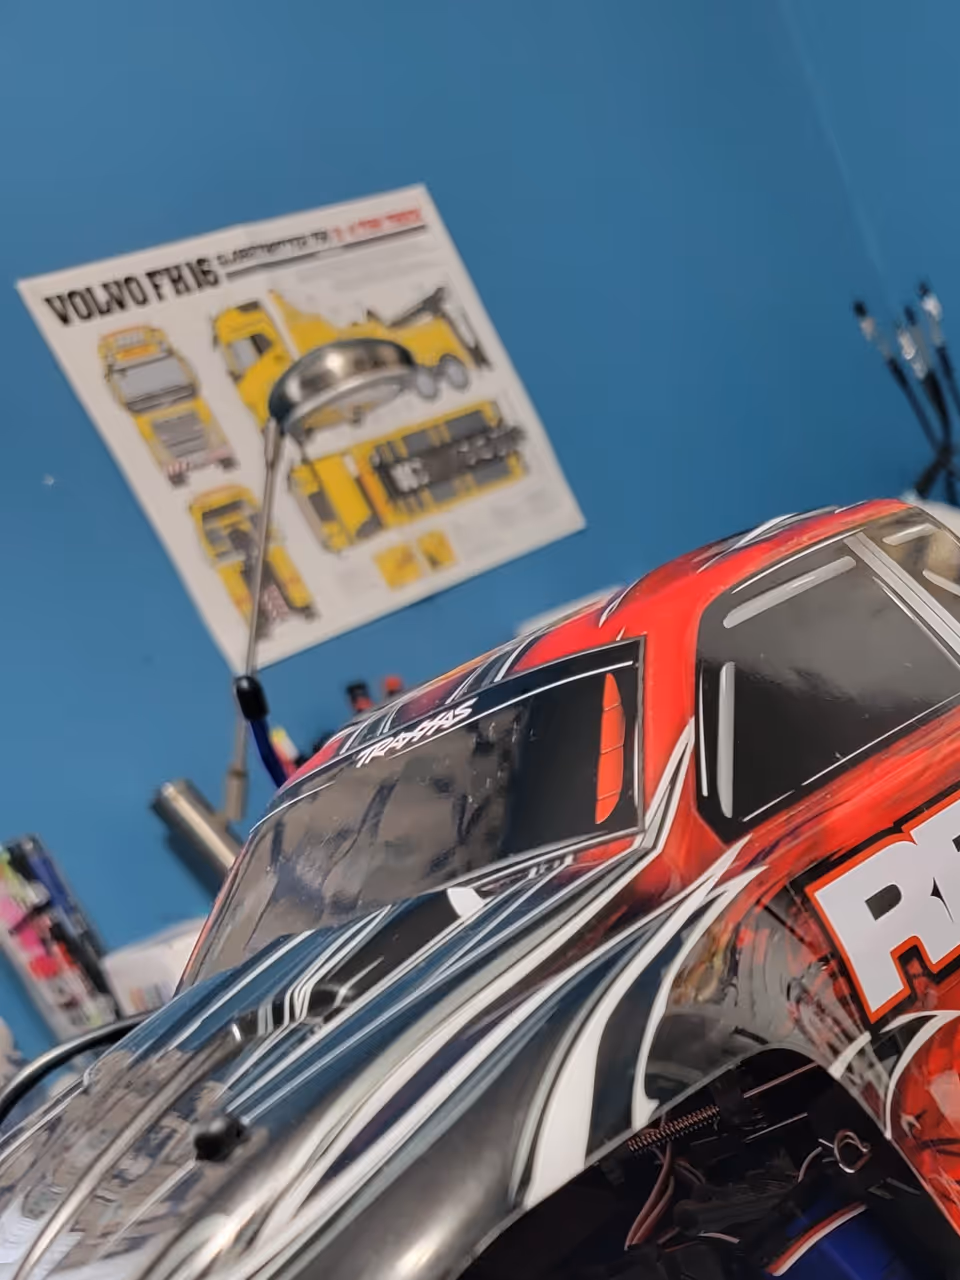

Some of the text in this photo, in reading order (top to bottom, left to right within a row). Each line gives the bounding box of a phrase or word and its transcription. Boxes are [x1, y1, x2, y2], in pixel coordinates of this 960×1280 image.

[45, 257, 220, 327] VOLVO FH16
[355, 697, 478, 768] TRAXXAS
